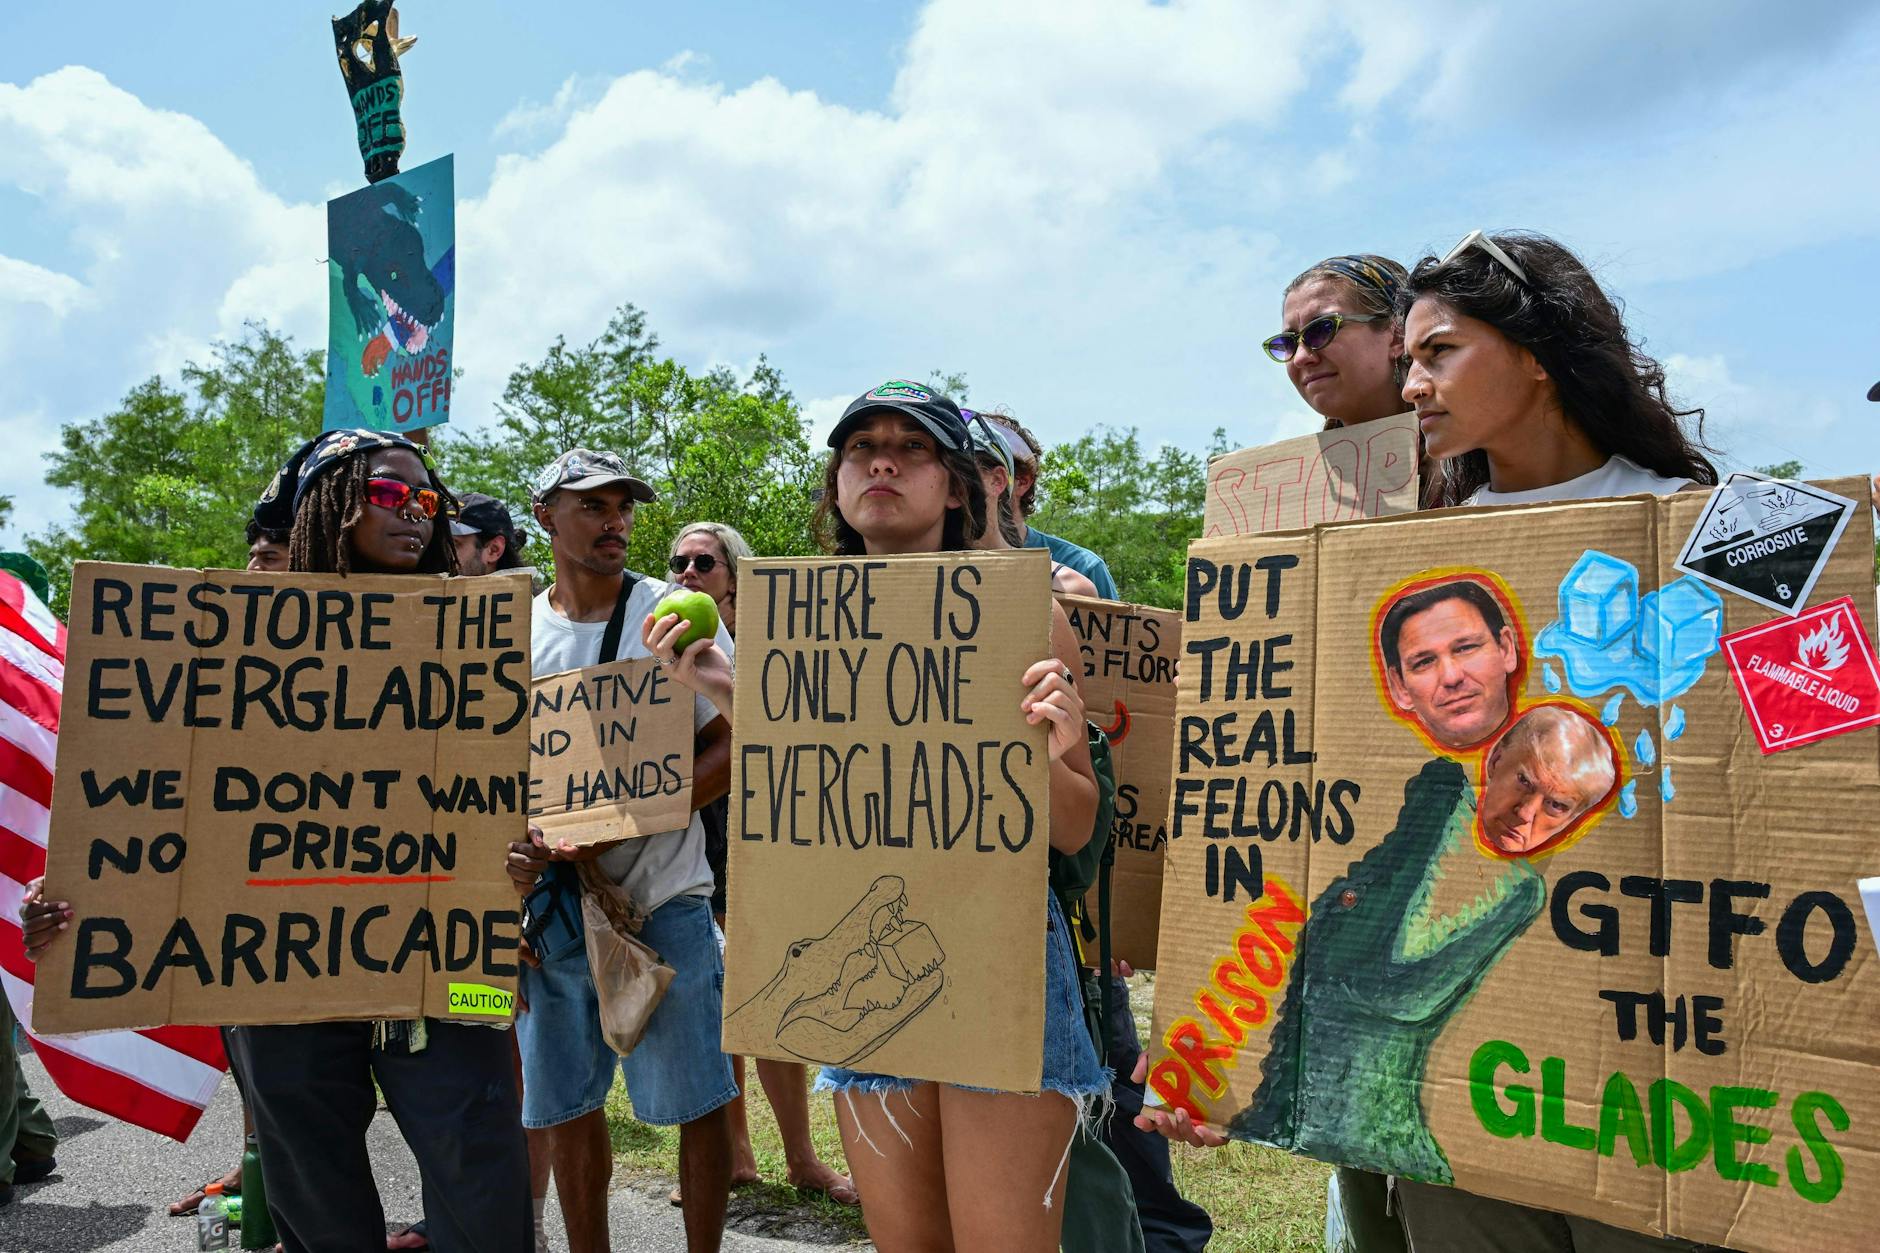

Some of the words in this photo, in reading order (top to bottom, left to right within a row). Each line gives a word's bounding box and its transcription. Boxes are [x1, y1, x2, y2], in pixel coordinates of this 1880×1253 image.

[391, 348, 448, 390] HANDS
[392, 376, 450, 423] OFF!
[1215, 427, 1419, 536] STOP
[1726, 526, 1809, 567] CORROSIVE
[92, 578, 394, 650] RESTORE
[424, 592, 514, 649] THE
[753, 563, 887, 641] THERE
[934, 565, 982, 641] IS
[1186, 554, 1299, 622] PUT
[1776, 583, 1792, 600] 8
[88, 651, 529, 734] EVERGLADES
[532, 666, 671, 717] NATIVE
[762, 647, 868, 723] ONLY
[886, 642, 977, 726] ONE
[1187, 634, 1294, 703] THE
[1747, 654, 1821, 697] FLAMMABLE
[1817, 684, 1860, 714] LIQUID
[600, 717, 636, 747] IN
[1180, 709, 1317, 773] REAL
[1769, 723, 1784, 738] 3
[80, 769, 184, 809] WE
[213, 767, 401, 812] DONT
[566, 754, 682, 811] HANDS
[741, 740, 1034, 853] EVERGLADES
[1173, 777, 1360, 845] FELONS
[88, 832, 186, 880] NO
[248, 821, 456, 873] PRISON
[1206, 843, 1263, 902] IN
[70, 905, 519, 999] BARRICADE
[1550, 871, 1857, 983] GTFO
[450, 992, 513, 1009] CAUTION
[1149, 876, 1309, 1126] PRISON
[1599, 989, 1727, 1055] THE
[1468, 1040, 1850, 1204] GLADES
